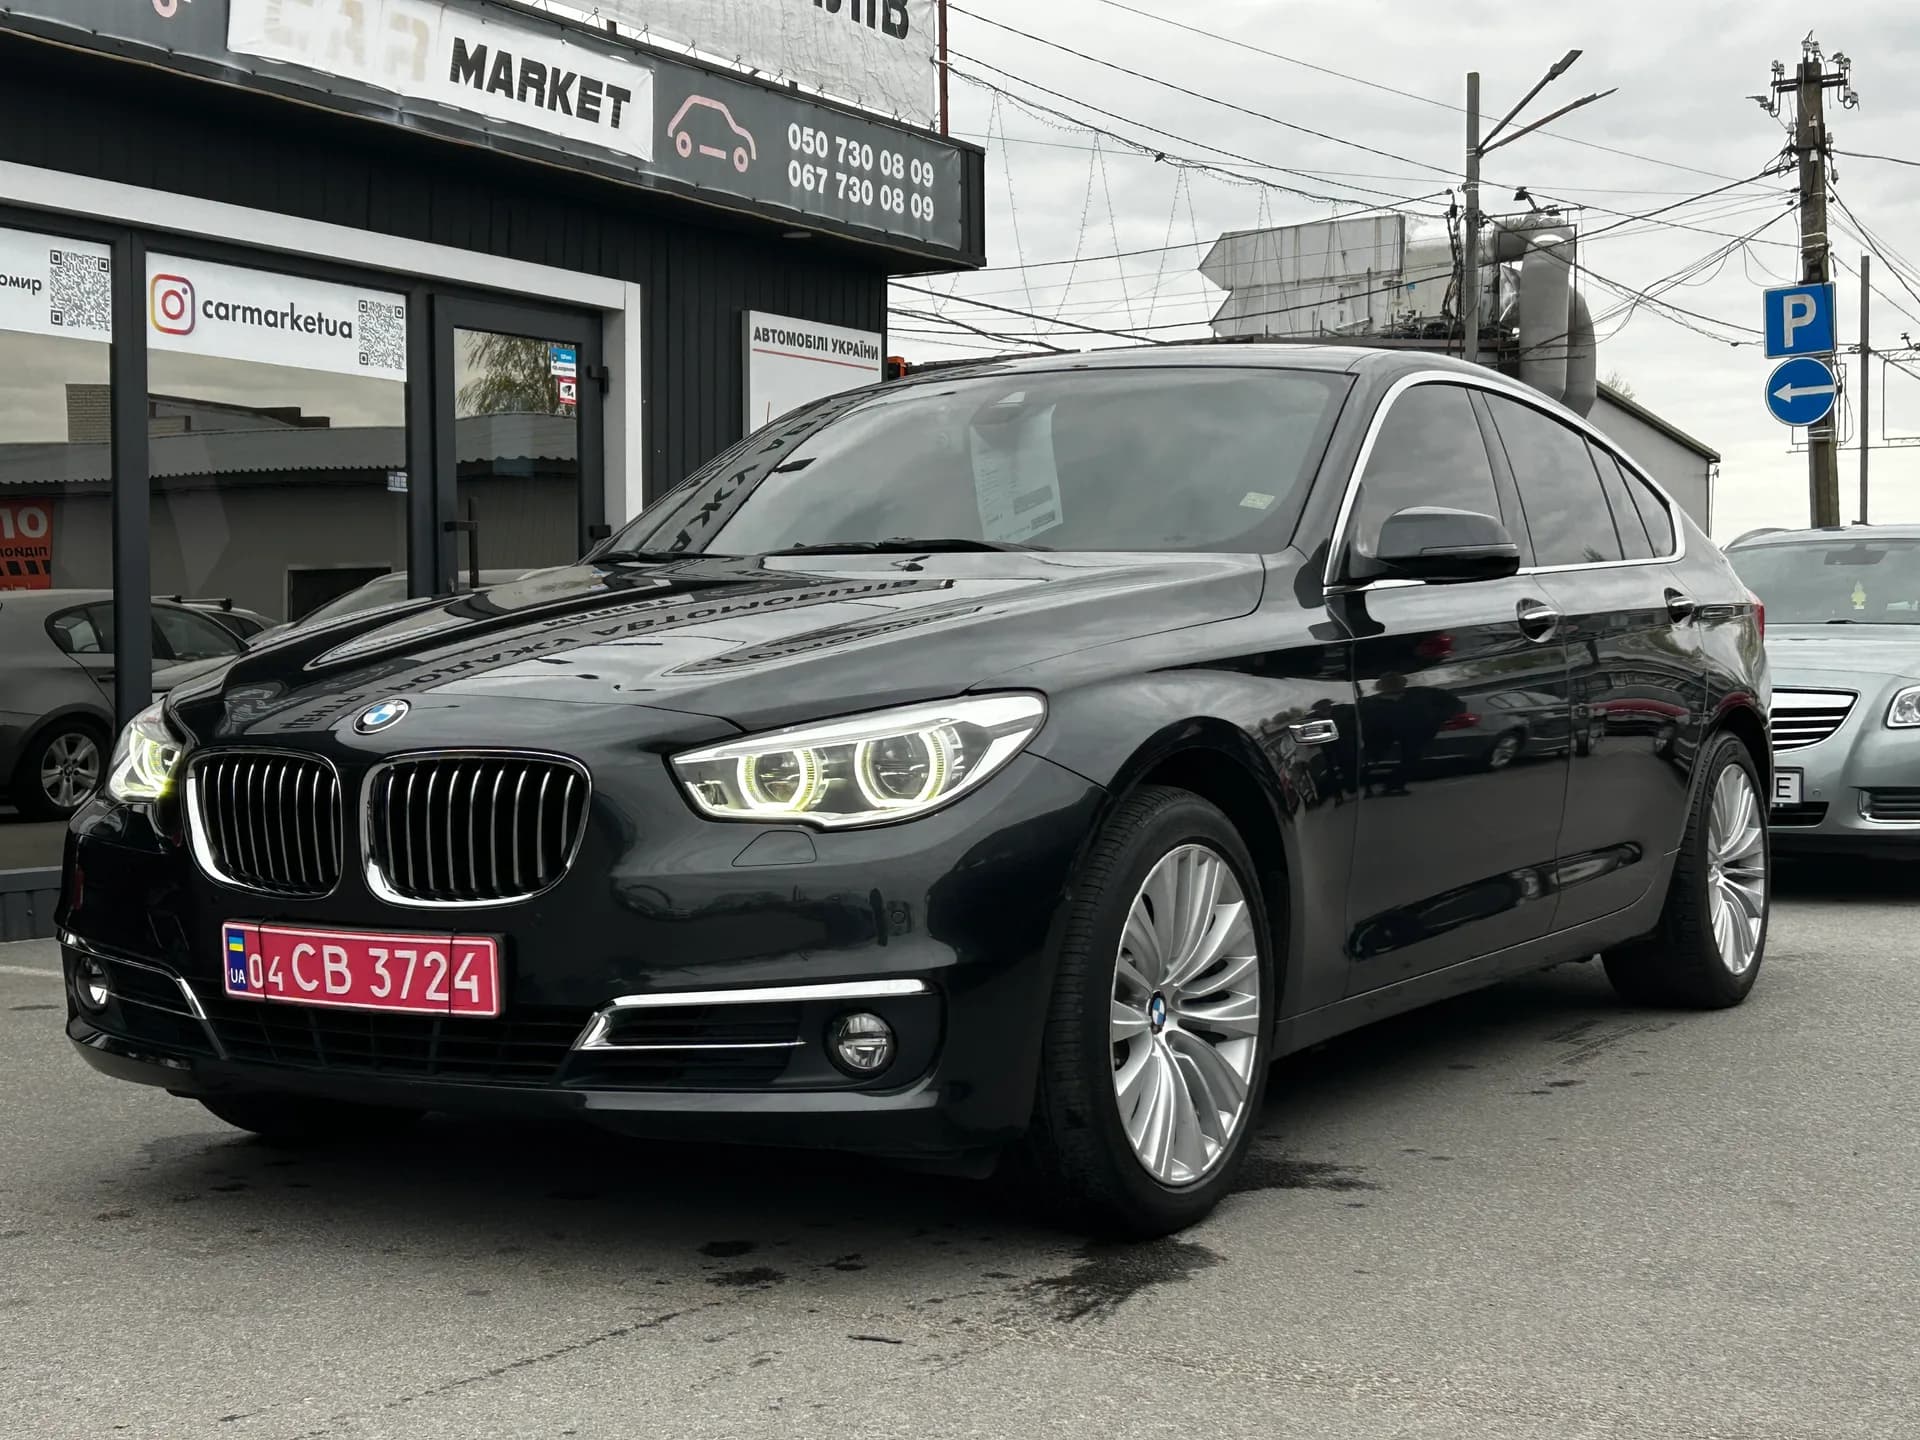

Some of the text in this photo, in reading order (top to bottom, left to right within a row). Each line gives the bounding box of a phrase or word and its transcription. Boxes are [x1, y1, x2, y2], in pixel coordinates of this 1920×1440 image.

[449, 37, 632, 129] MARKET
[788, 122, 934, 188] 050 730 08 09
[788, 159, 934, 222] 067 730 08 09
[202, 300, 353, 339] carmarketua
[753, 326, 879, 361] АВТОМОБІЛІ УКРАЇНИ
[1783, 293, 1817, 349] P
[230, 967, 246, 984] UA
[368, 947, 480, 1003] 3724
